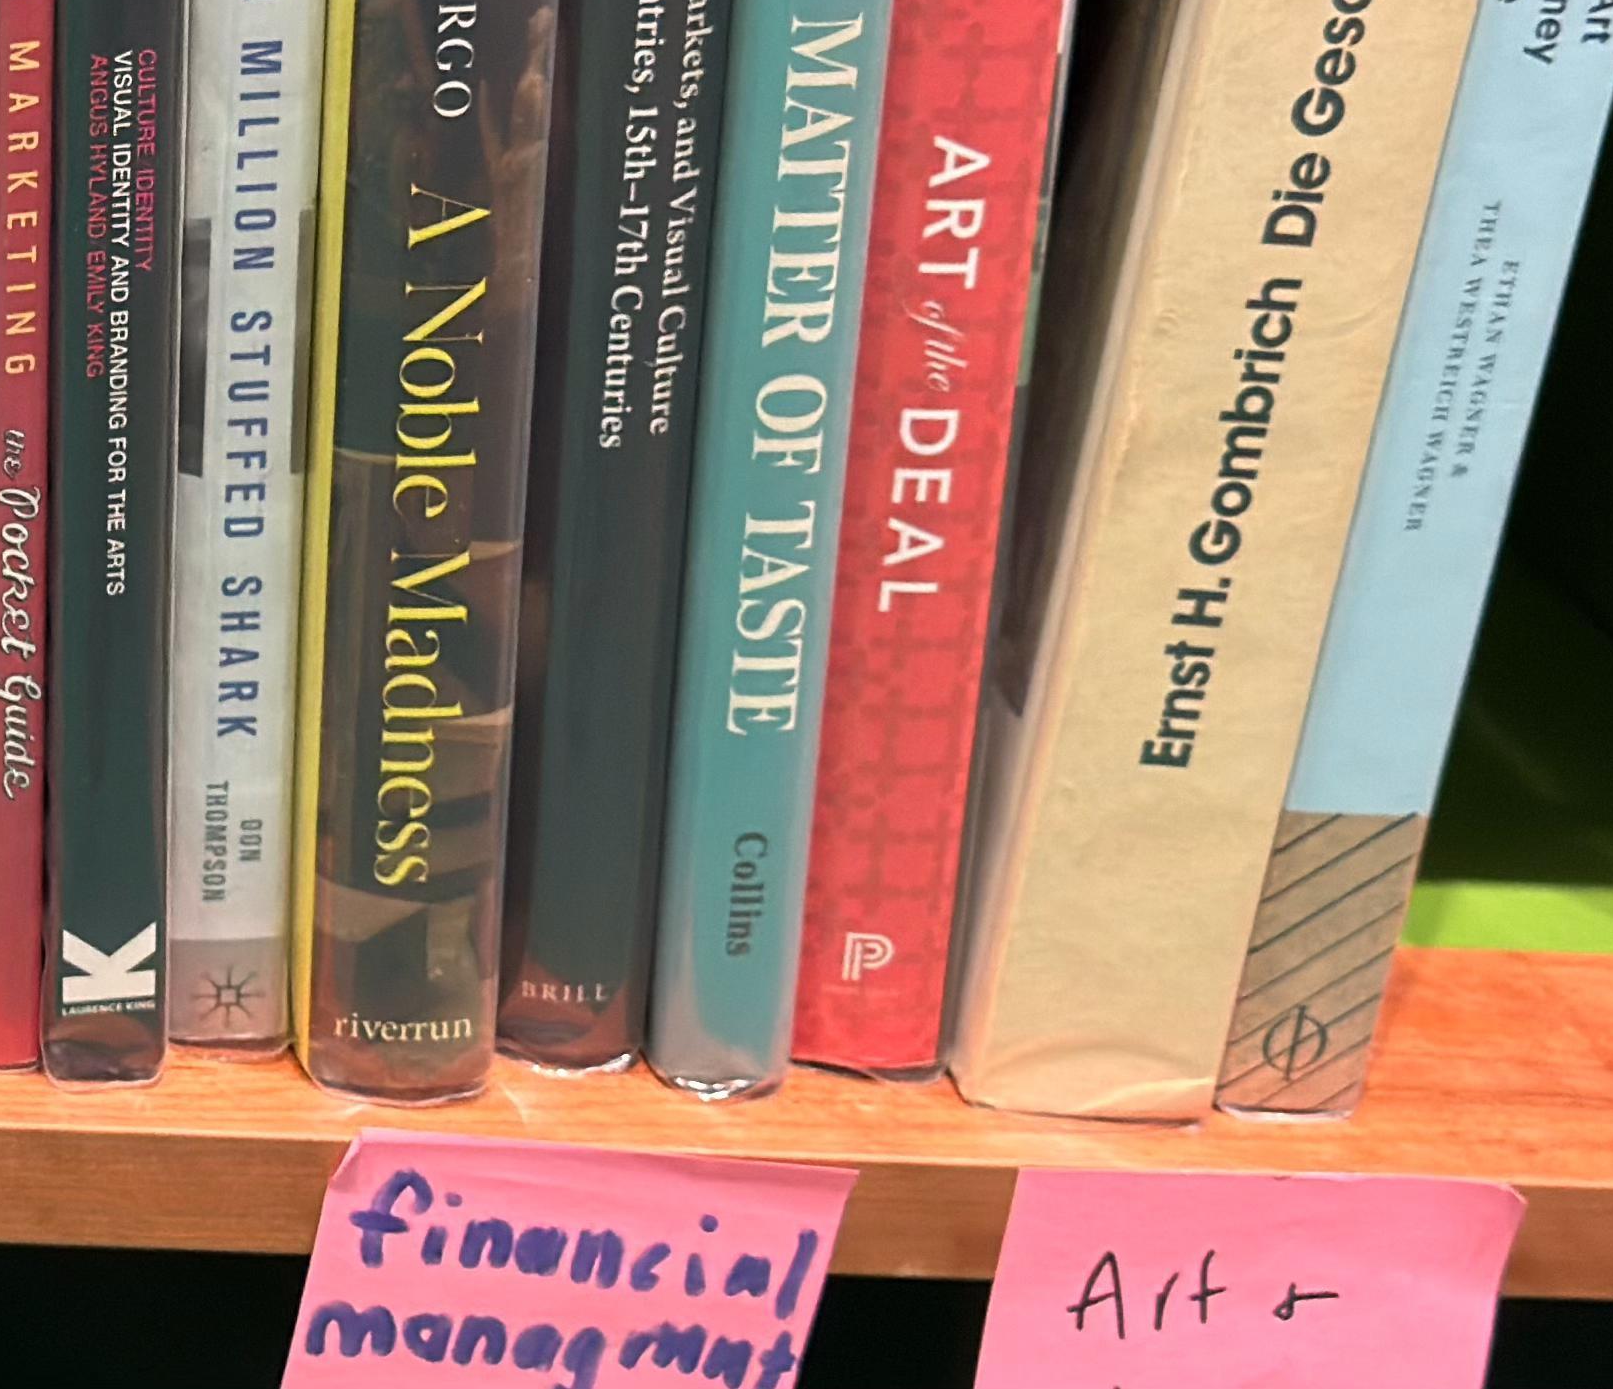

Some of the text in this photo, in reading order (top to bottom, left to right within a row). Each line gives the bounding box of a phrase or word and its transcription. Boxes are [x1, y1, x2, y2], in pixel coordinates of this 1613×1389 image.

[4, 39, 40, 376] MARKETING
[232, 41, 283, 271] MILLION
[408, 183, 491, 250] A
[673, 117, 698, 182] and
[761, 12, 864, 350] MATTER
[1262, 152, 1332, 248] Die
[661, 186, 699, 295] Visual
[222, 310, 272, 538] STUFFED
[391, 277, 487, 518] Noble
[650, 303, 687, 436] Culture
[750, 372, 829, 476] OF
[1188, 277, 1303, 566] Gombrich
[217, 576, 262, 737] SHARK
[727, 500, 819, 736] TASTE
[1171, 577, 1232, 629] H.
[373, 547, 471, 887] Madness
[1139, 639, 1215, 768] Ernst
[333, 1013, 472, 1042] riverrun
[349, 1169, 818, 1320] financial
